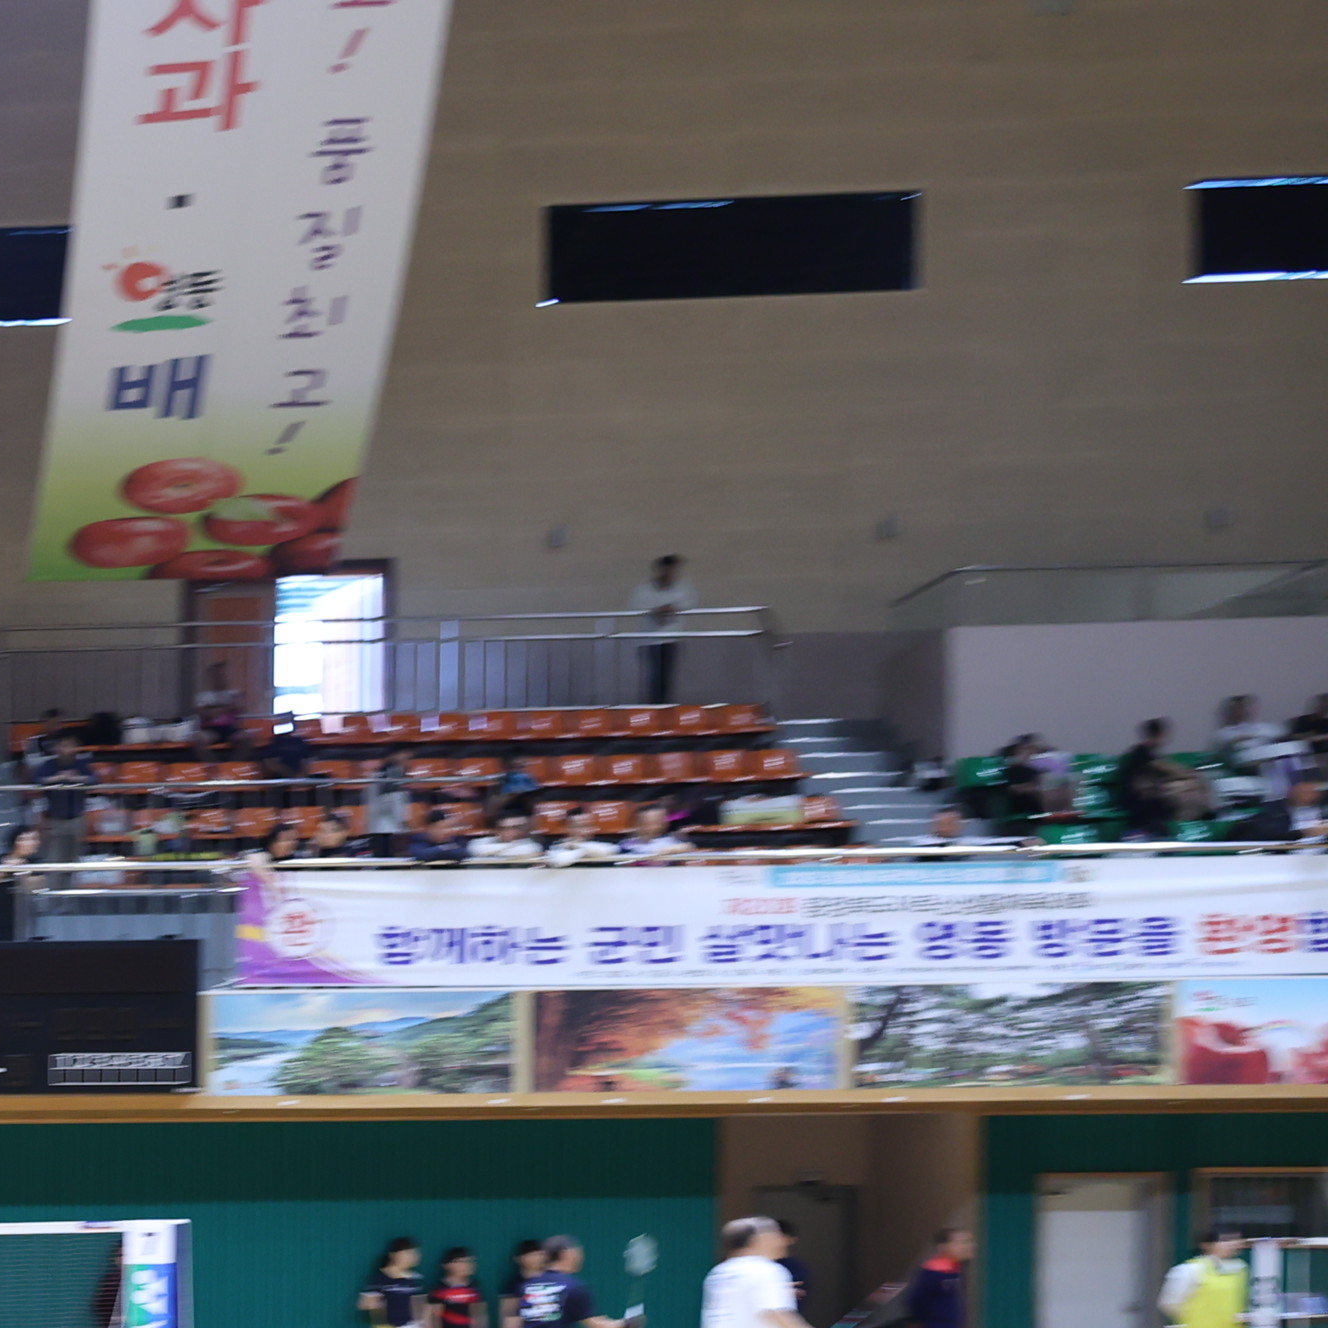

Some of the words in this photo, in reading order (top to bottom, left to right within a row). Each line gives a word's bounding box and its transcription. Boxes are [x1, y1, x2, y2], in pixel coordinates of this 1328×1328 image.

[105, 354, 213, 420] 배
[374, 925, 568, 965] 함께하는
[585, 924, 684, 964] 군민
[699, 922, 898, 963] 살맛나는
[912, 919, 1011, 960] 영동
[1031, 916, 1183, 957] 방문을
